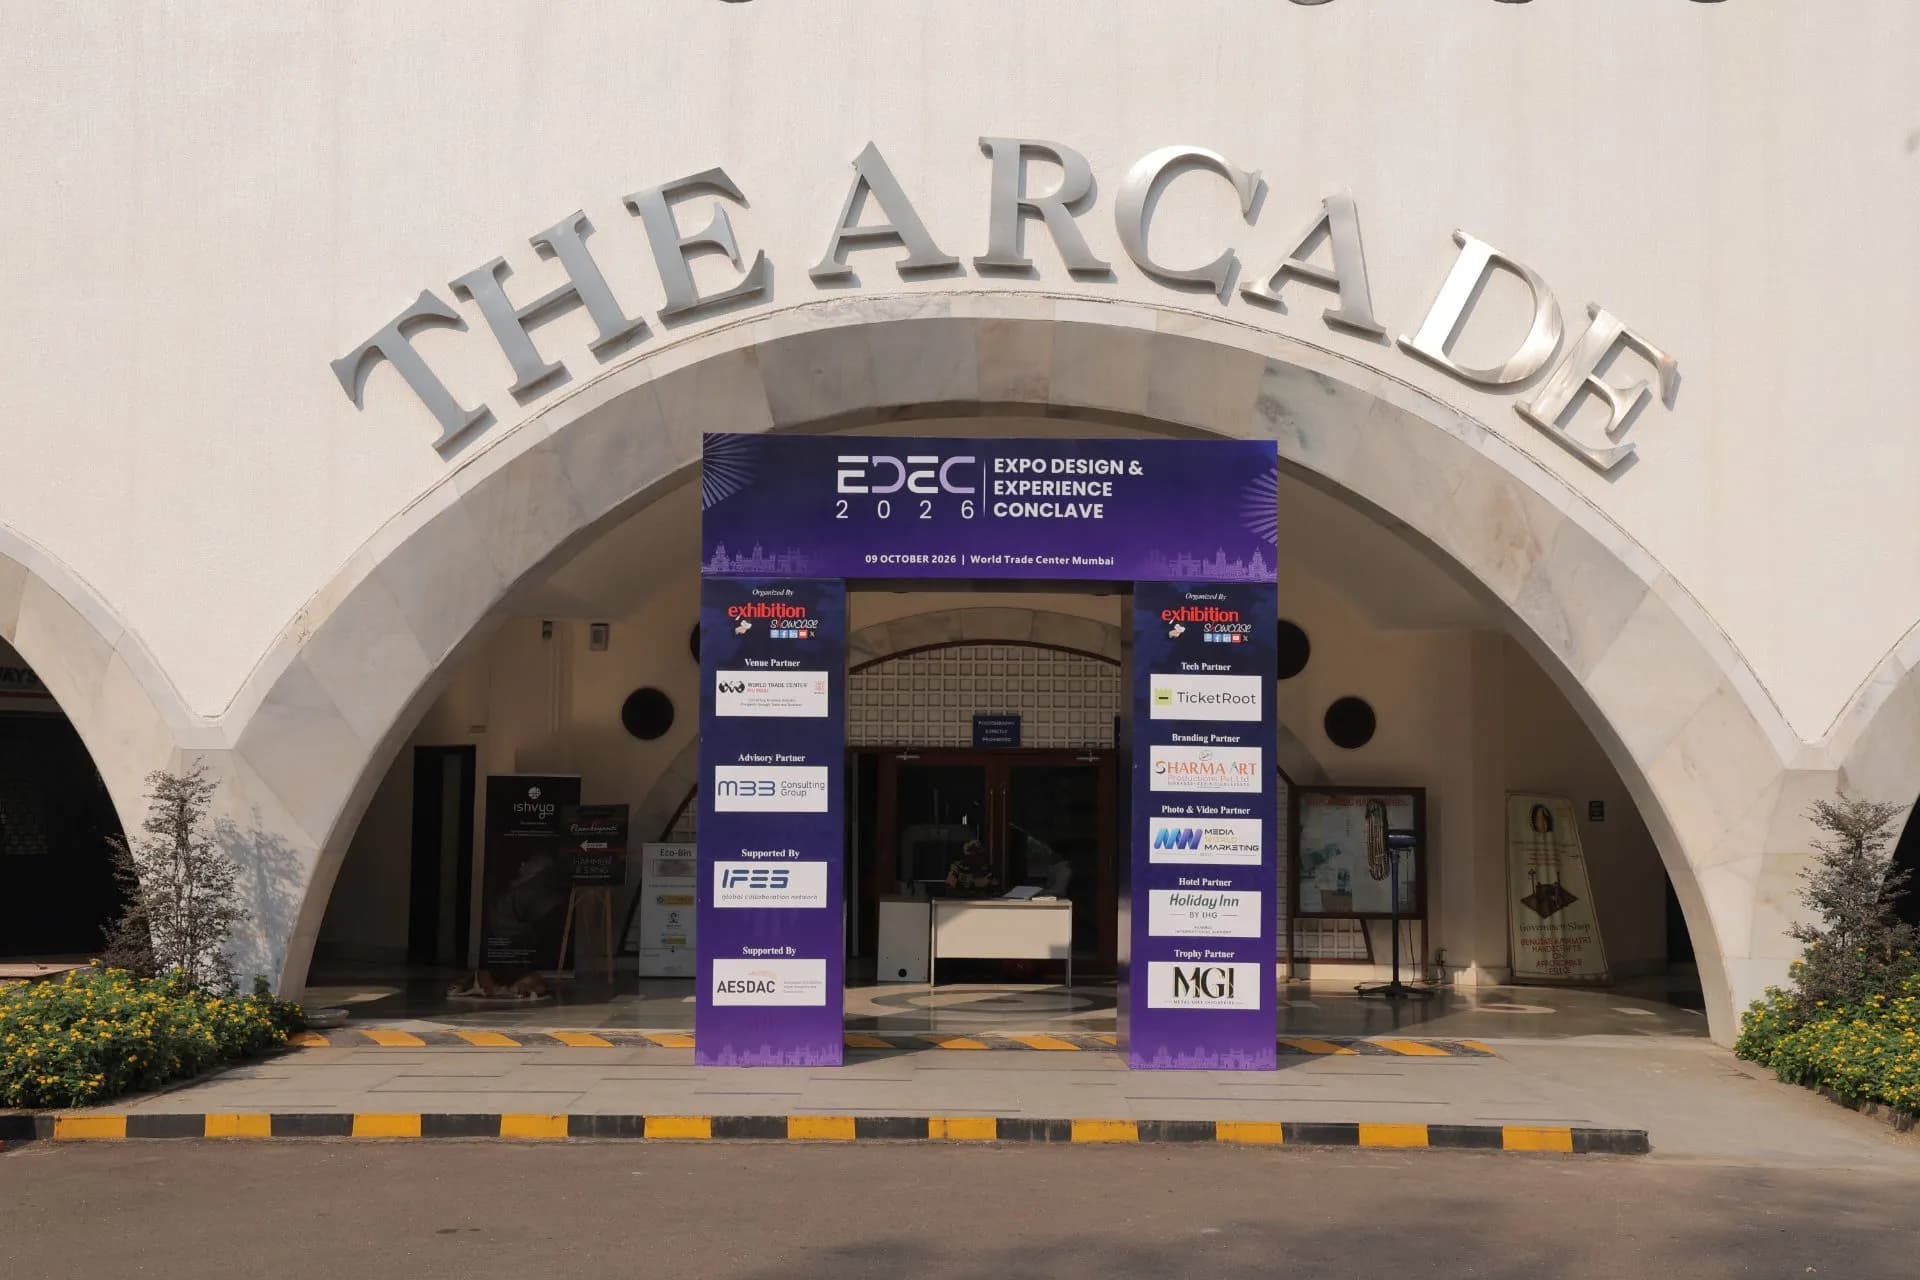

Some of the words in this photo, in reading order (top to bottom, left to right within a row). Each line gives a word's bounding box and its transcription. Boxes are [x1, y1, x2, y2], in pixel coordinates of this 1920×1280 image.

[329, 167, 769, 458] THE
[809, 136, 1679, 471] ARCADE
[994, 458, 1047, 473] EXPO
[1051, 458, 1124, 475] DESIGN
[1128, 460, 1144, 476] &
[838, 455, 976, 494] EDEC
[993, 480, 1113, 497] EXPERIENCE
[835, 500, 974, 519] 2026
[993, 502, 1104, 519] CONCLAVE
[865, 554, 878, 564] 09
[880, 554, 930, 564] OCTOBER
[931, 554, 957, 564] 2026
[970, 554, 1002, 564] World
[1003, 554, 1034, 565] Trade
[1035, 555, 1071, 565] Center
[1072, 556, 1114, 566] Mumbai
[752, 589, 785, 597] Organized
[785, 589, 794, 597] By
[1185, 592, 1218, 601] Organized
[727, 602, 806, 618] exhibition
[1161, 606, 1239, 622] exhibition
[744, 658, 769, 667] Venue
[770, 658, 801, 667] Partner
[1181, 661, 1199, 671] Tech
[1201, 662, 1232, 671] Partner
[1176, 691, 1257, 705] TicketRoot
[1172, 733, 1209, 743] Branding
[1210, 734, 1240, 743] Partner
[738, 753, 774, 764] Advisory
[775, 753, 806, 762] Partner
[1155, 760, 1226, 775] SHARMA
[1230, 761, 1257, 775] ART
[780, 780, 826, 791] Consulting
[780, 789, 807, 798] Group
[1161, 805, 1185, 814] Photo
[1186, 806, 1194, 814] &
[1195, 805, 1219, 814] Video
[1220, 806, 1251, 815] Partner
[1204, 828, 1235, 836] MEDIA
[659, 848, 692, 857] Eco-Bin
[1204, 844, 1260, 852] MARKETING
[741, 849, 786, 859] Supported
[788, 849, 800, 859] By
[722, 869, 790, 889] IFES
[1178, 877, 1200, 886] Hotel
[1201, 878, 1233, 887] Partner
[1169, 893, 1218, 909] Holiday
[1219, 894, 1240, 907] Inn
[1201, 911, 1218, 919] IHG
[742, 946, 784, 956] Supported
[785, 946, 796, 956] By
[1173, 949, 1202, 959] Trophy
[1204, 949, 1235, 958] Partner
[716, 980, 776, 994] AESDAC
[1173, 966, 1235, 999] MGI
